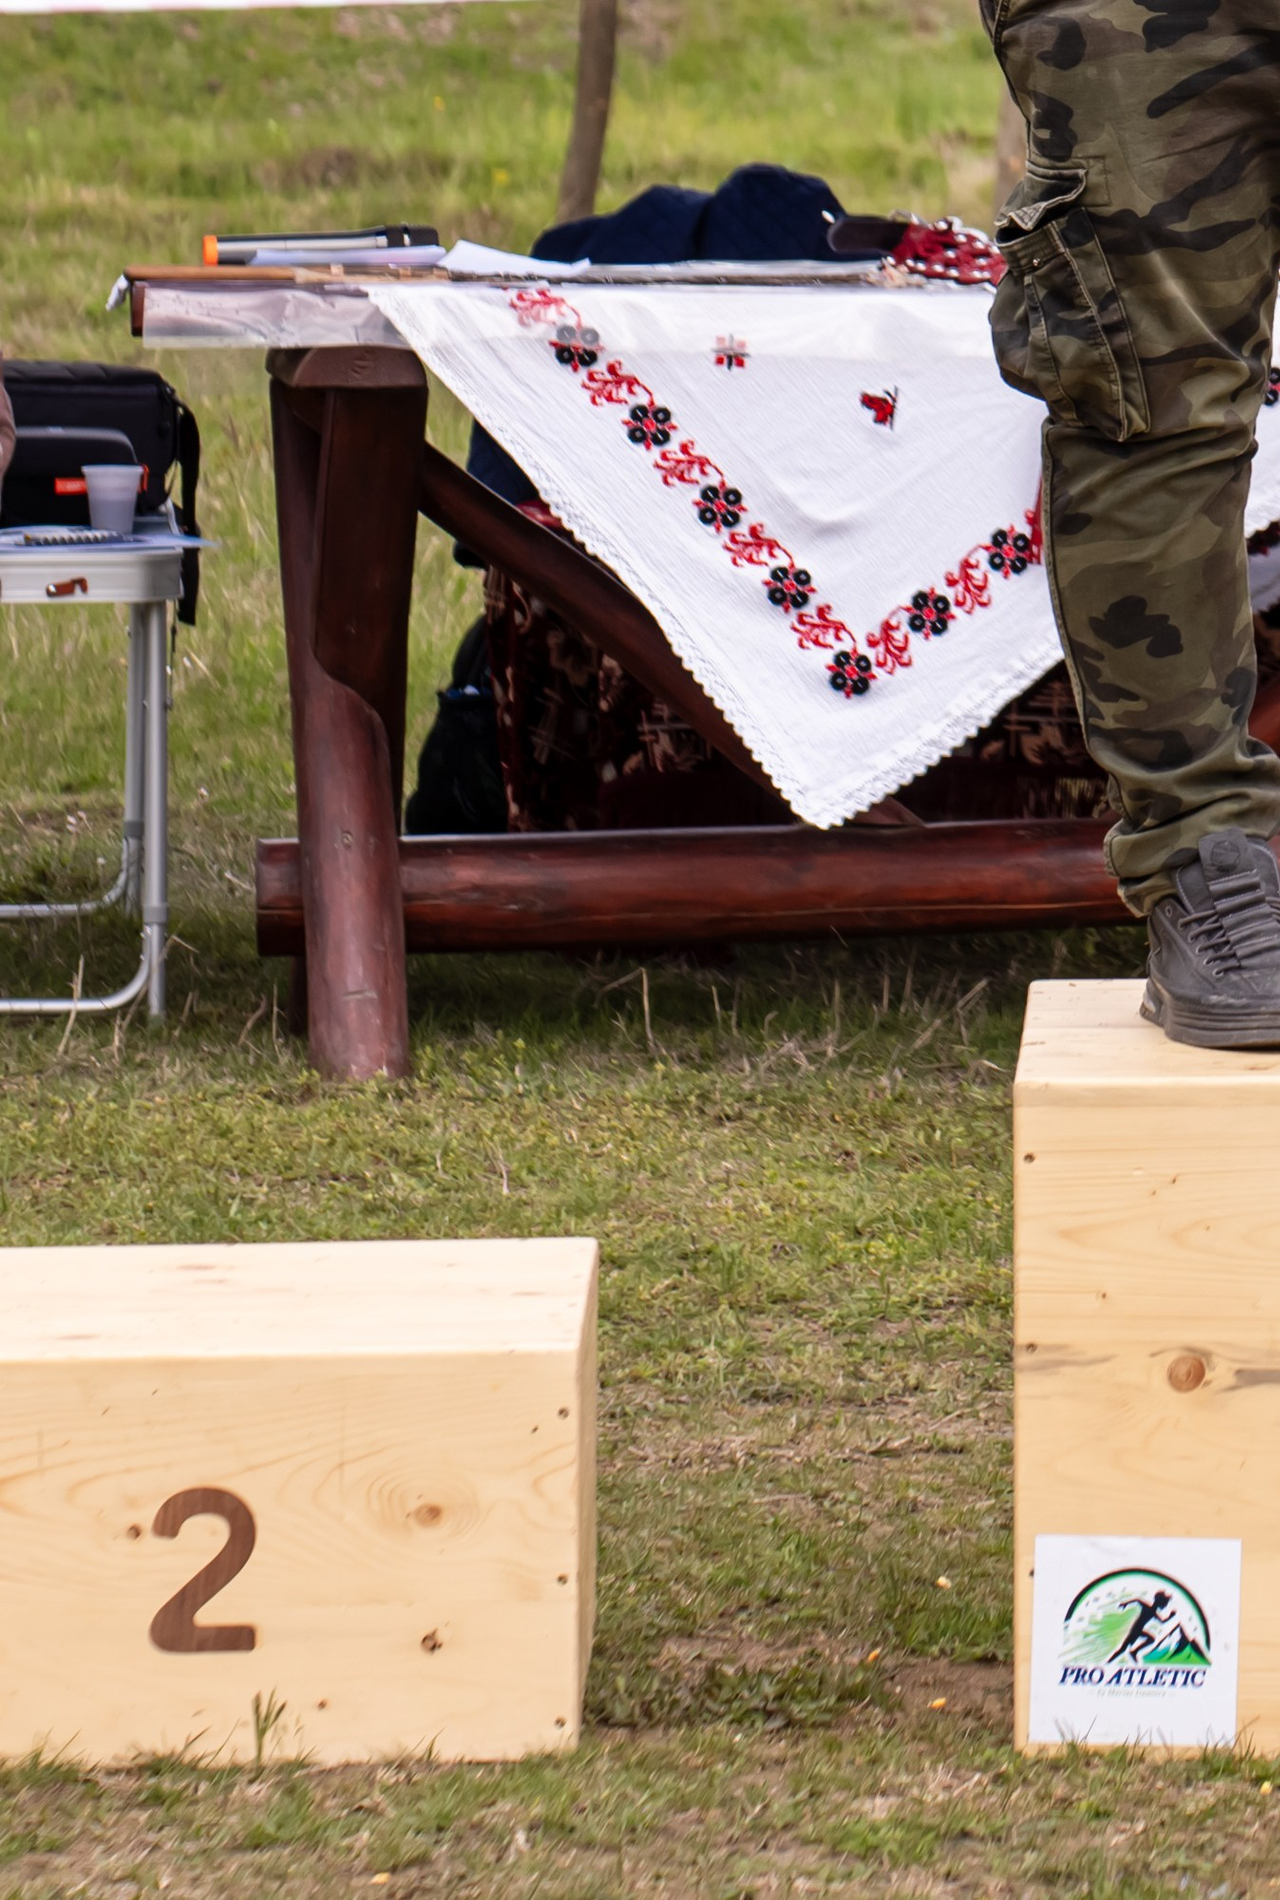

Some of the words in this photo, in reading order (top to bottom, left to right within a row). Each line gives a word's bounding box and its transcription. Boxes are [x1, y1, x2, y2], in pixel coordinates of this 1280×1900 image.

[149, 1487, 256, 1653] 2
[1059, 1666, 1105, 1685] PRO
[1106, 1668, 1207, 1688] ATLETIC
